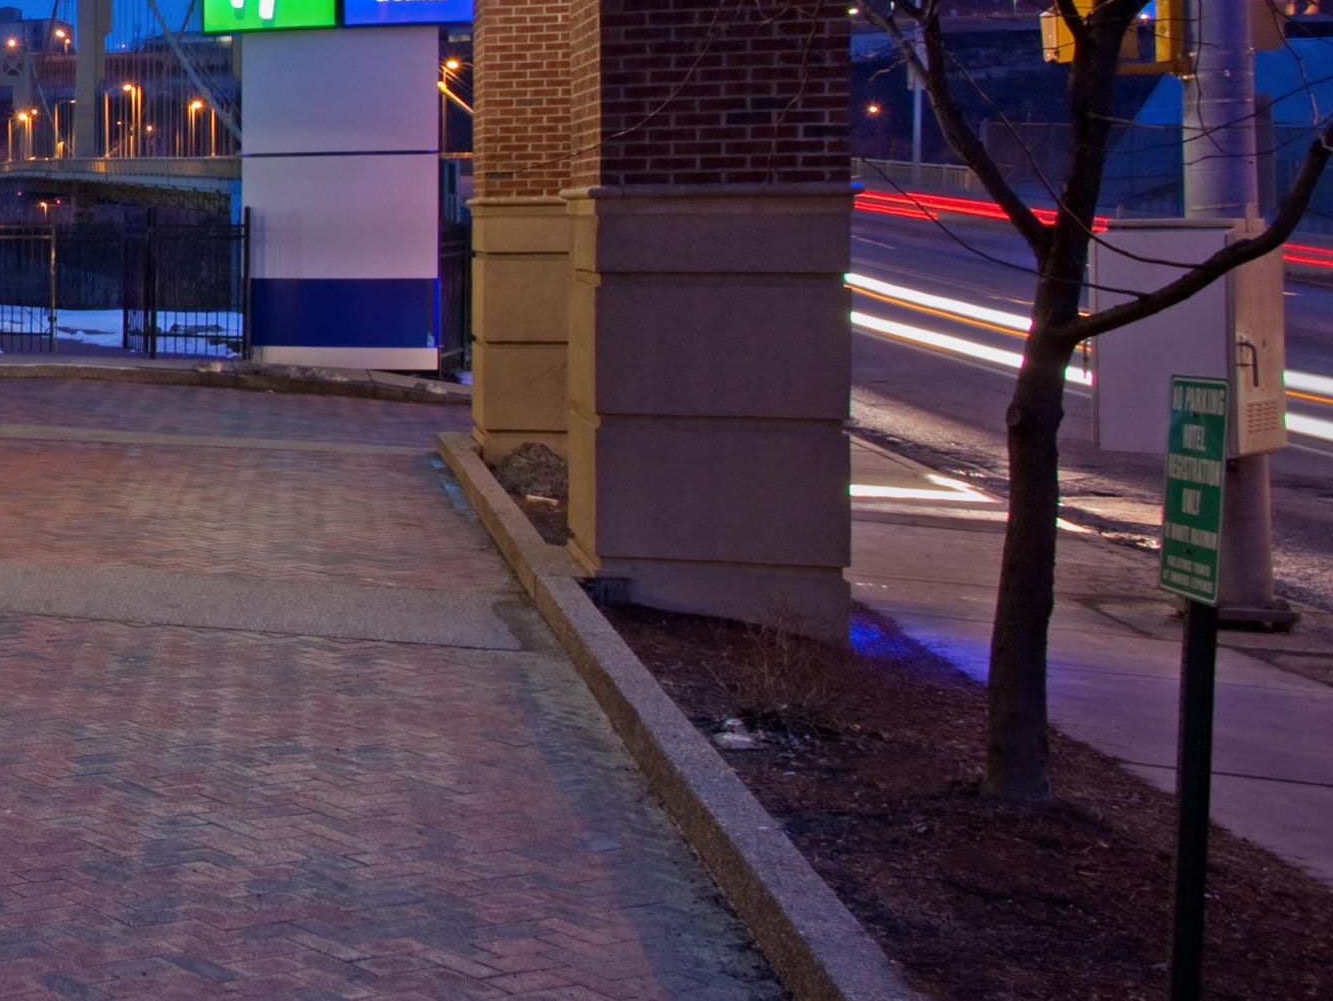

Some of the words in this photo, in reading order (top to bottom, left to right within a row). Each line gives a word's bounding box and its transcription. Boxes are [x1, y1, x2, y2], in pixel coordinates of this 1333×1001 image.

[1173, 385, 1183, 410] NO
[1184, 387, 1225, 415] PARKING
[1182, 423, 1205, 451] HOTEL
[1167, 453, 1221, 487] REGISTRATION
[1182, 488, 1201, 516] ONLY
